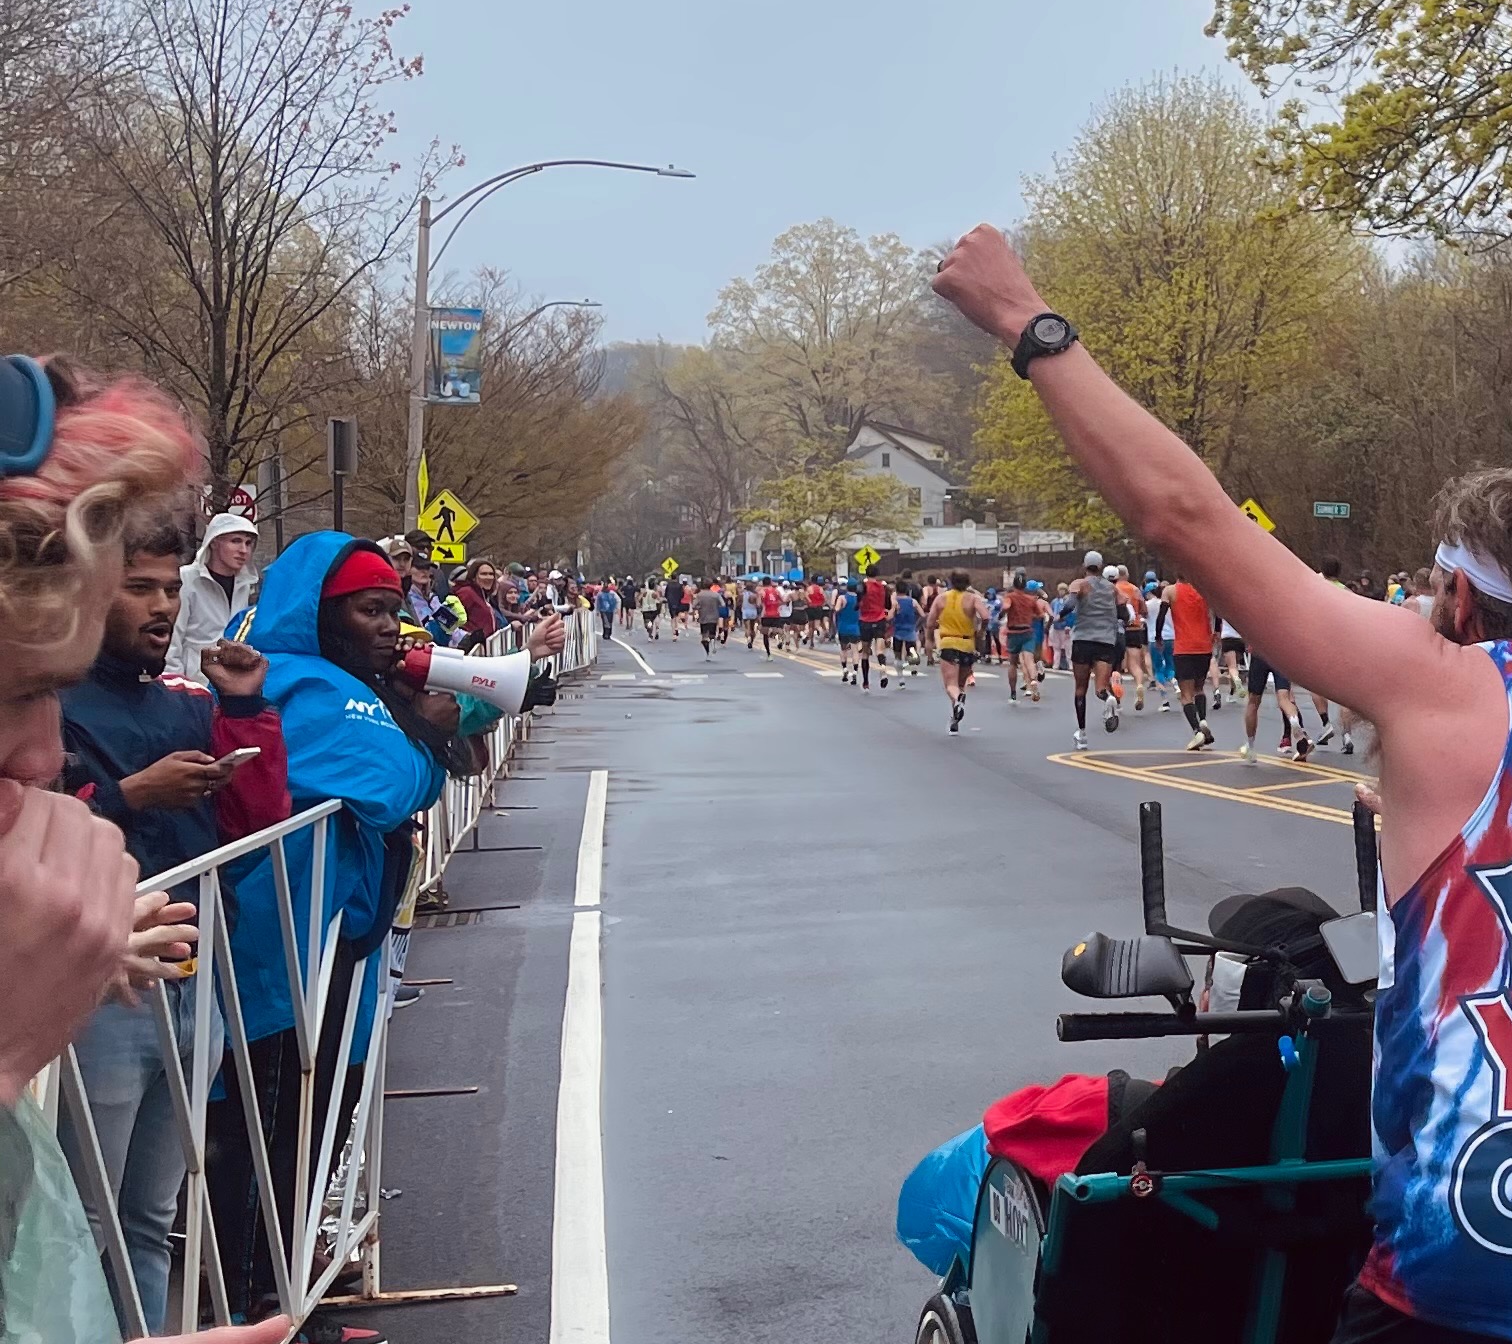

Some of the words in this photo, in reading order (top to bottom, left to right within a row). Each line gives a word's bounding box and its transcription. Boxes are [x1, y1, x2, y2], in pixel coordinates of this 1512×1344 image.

[431, 320, 481, 330] NEWTON
[1000, 543, 1017, 553] 30
[471, 675, 497, 689] PYLE
